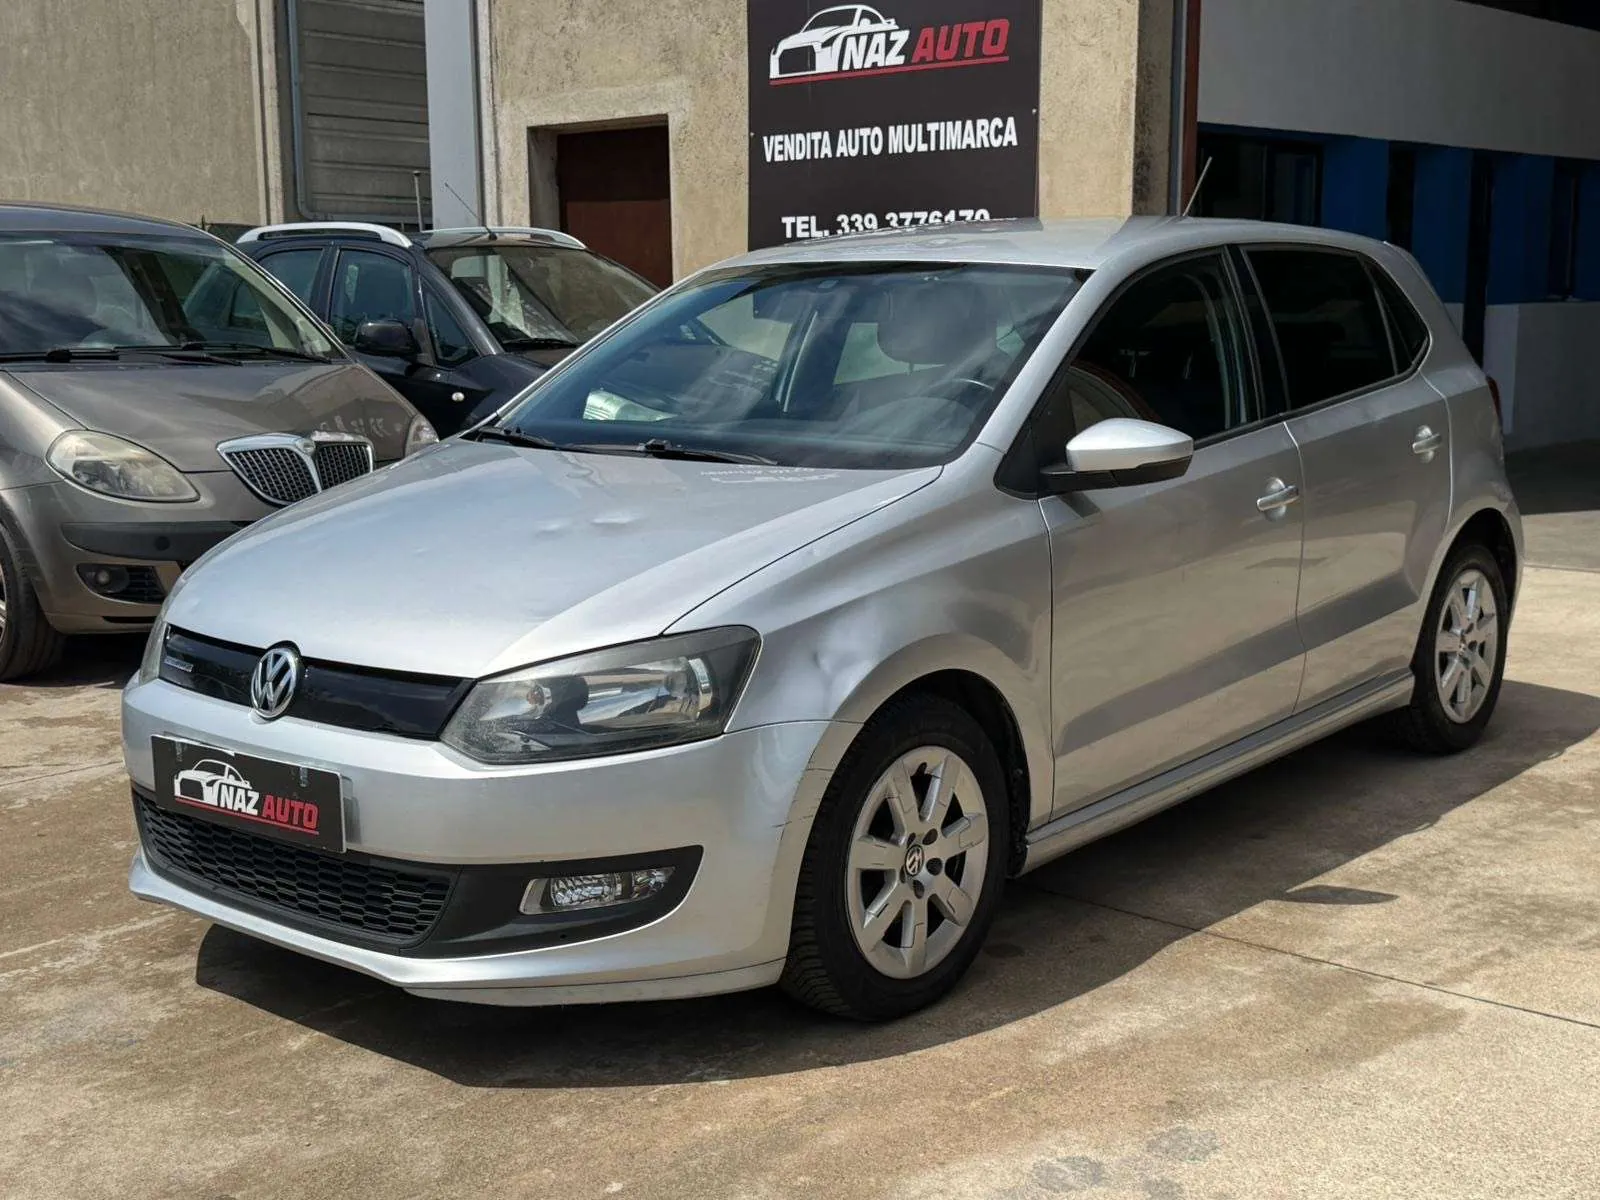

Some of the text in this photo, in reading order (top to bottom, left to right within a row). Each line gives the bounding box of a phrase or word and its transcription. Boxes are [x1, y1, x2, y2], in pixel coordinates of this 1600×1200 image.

[842, 18, 1010, 71] NAZ AUTO
[763, 117, 1018, 162] VENDITA AUTO MULTIMARCA
[781, 215, 829, 238] TEL.
[836, 213, 878, 234] 339
[220, 784, 318, 829] NAZ AUTO
